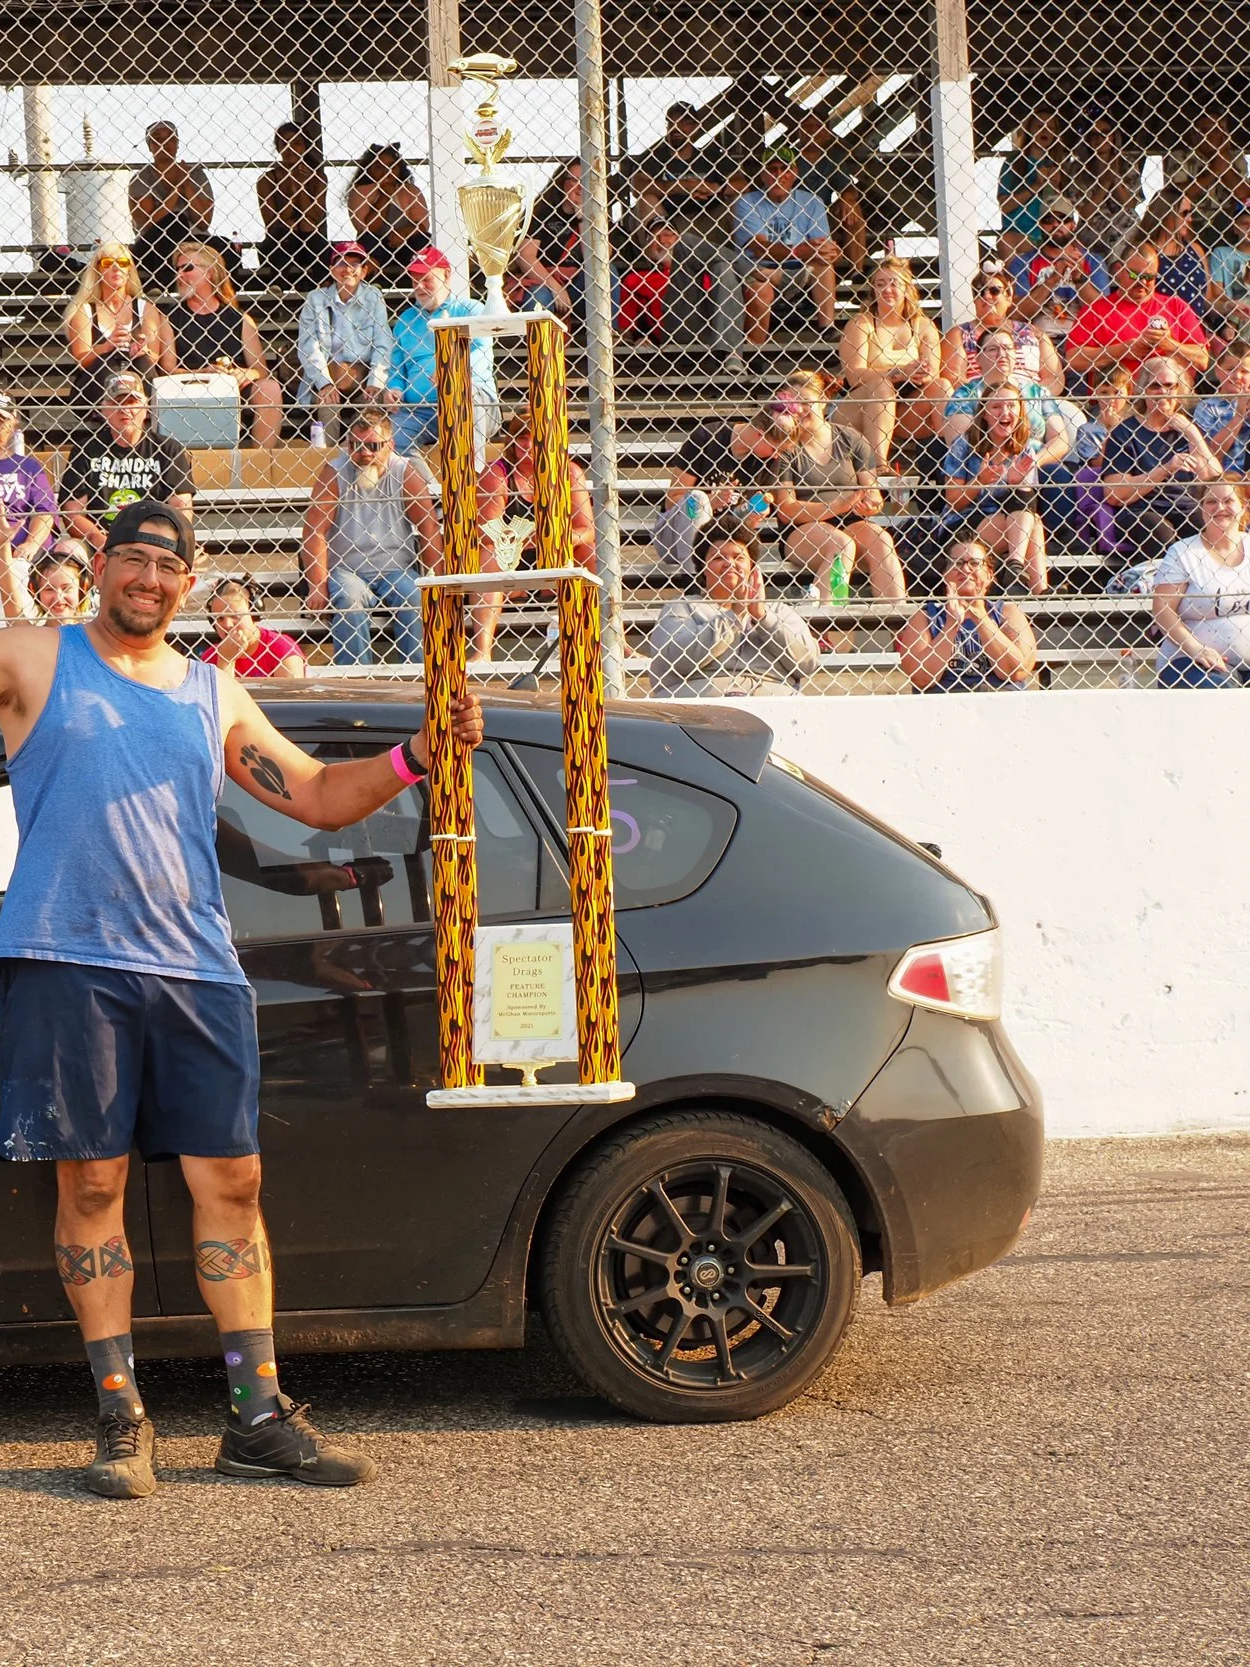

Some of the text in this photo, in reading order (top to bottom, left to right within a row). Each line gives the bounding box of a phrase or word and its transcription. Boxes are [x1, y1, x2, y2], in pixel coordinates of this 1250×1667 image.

[90, 456, 162, 474] GRANDPA
[98, 473, 154, 489] SHARK
[502, 954, 553, 964] Spectator
[512, 967, 543, 977] Drags
